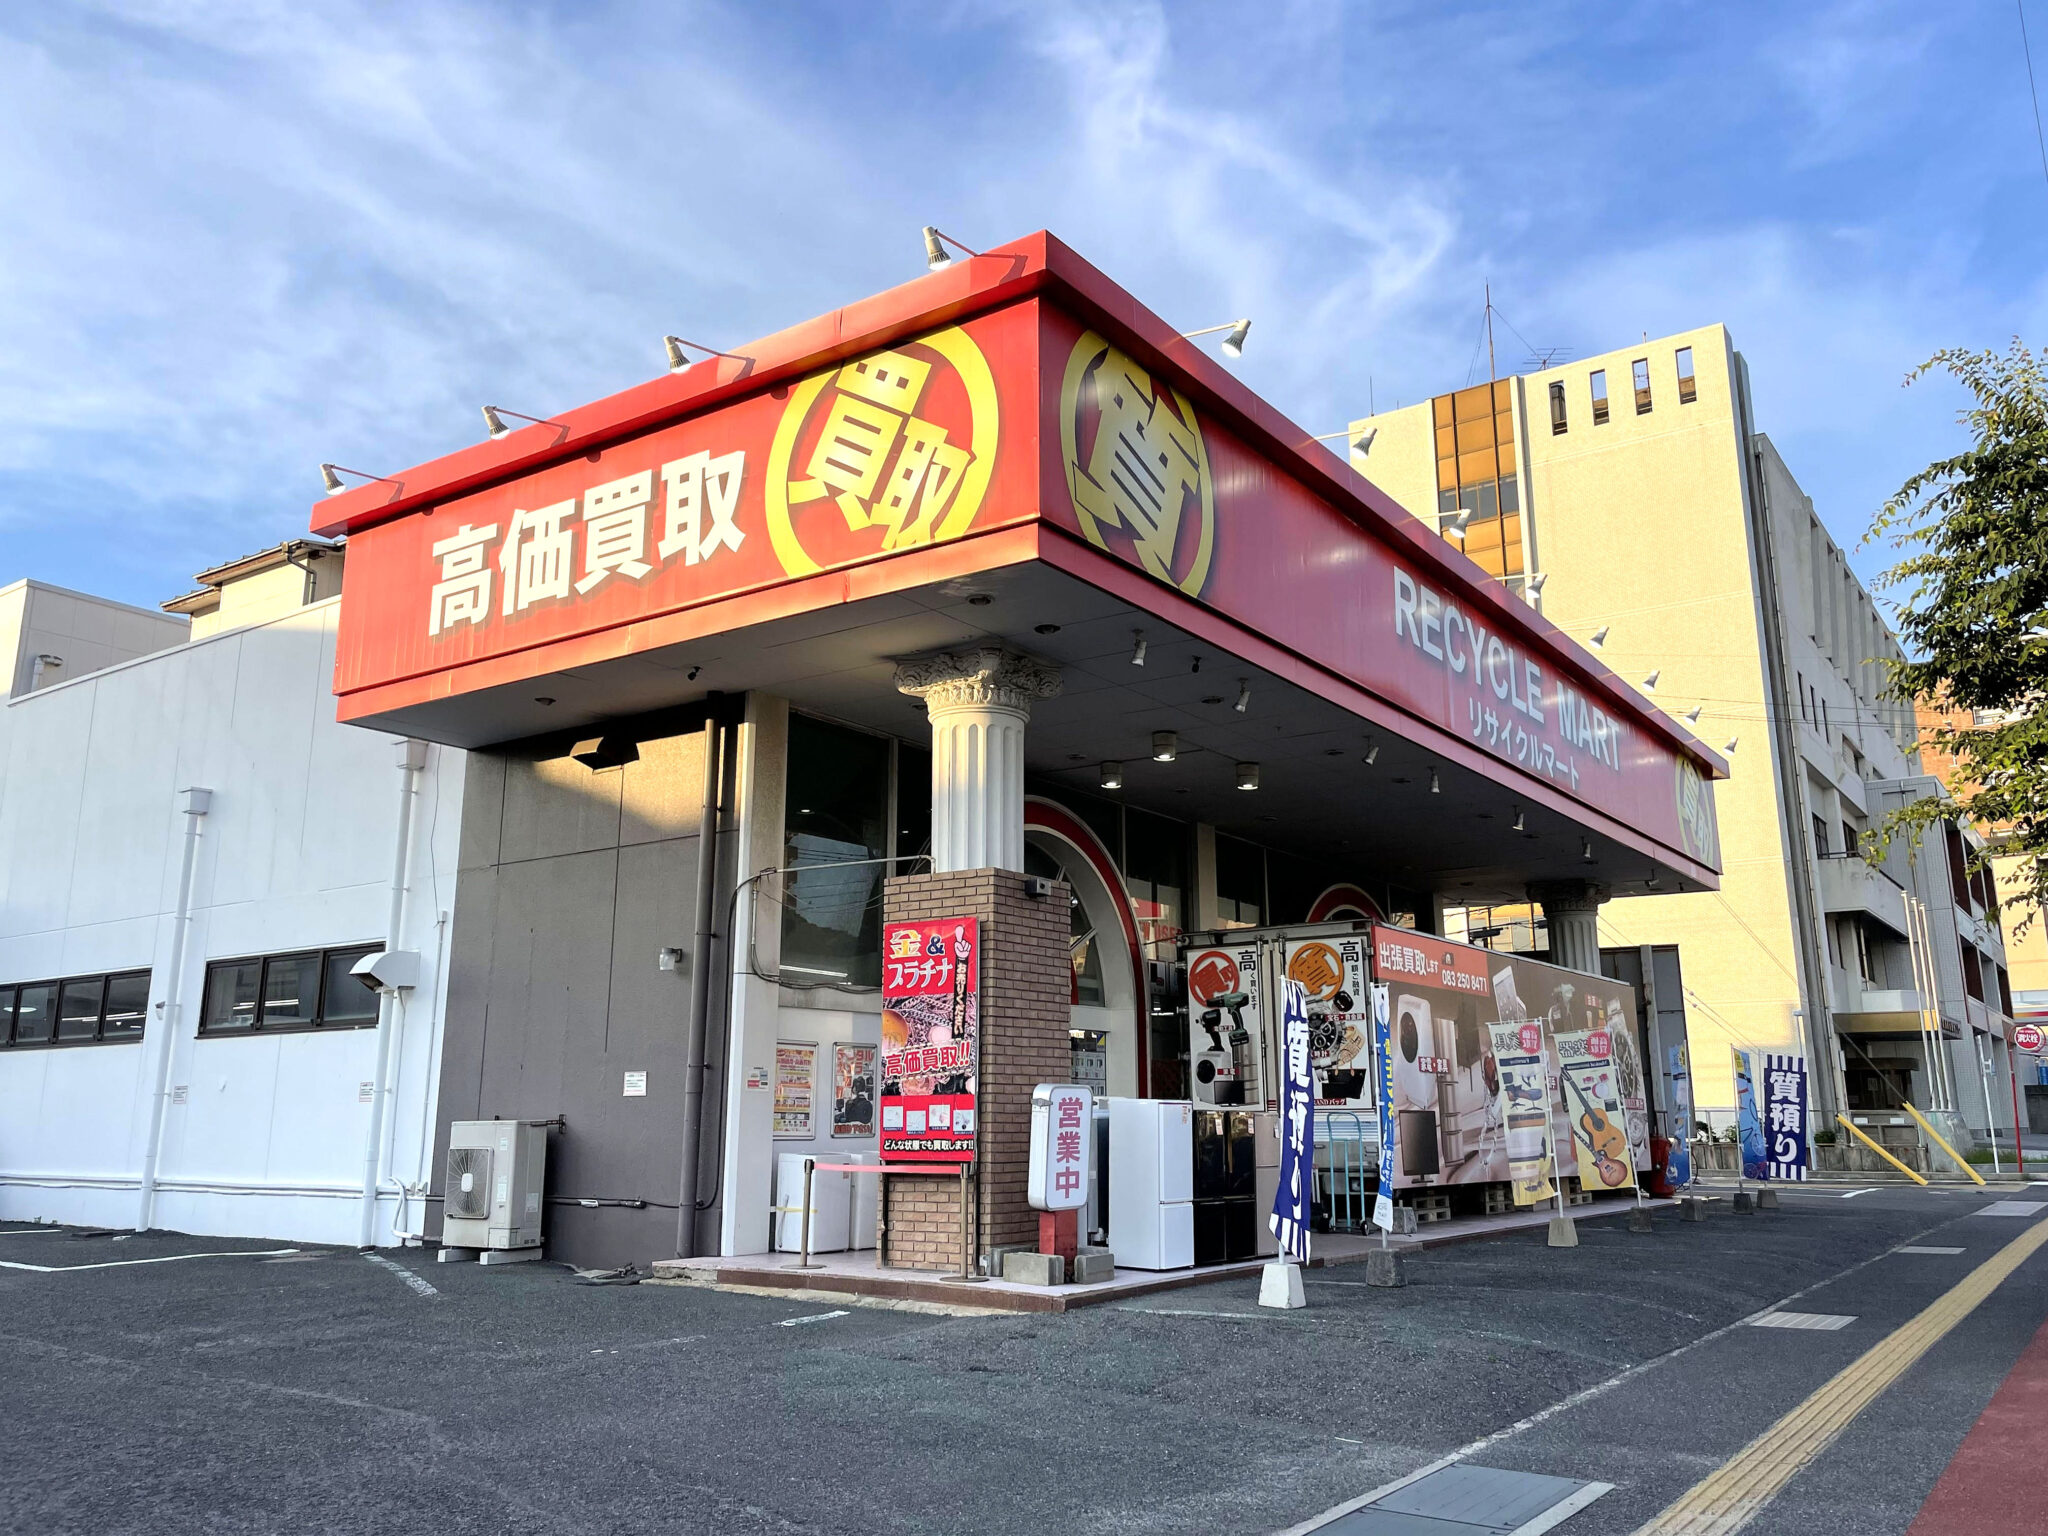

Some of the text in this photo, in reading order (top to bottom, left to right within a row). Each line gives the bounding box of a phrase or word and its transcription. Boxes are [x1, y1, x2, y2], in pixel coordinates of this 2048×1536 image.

[788, 349, 971, 551] 買取
[429, 449, 746, 637] 高価買取
[1393, 566, 1621, 771] RECYCLE MART
[1469, 697, 1580, 790] リサイクルマート
[888, 958, 953, 989] プラチナ
[954, 963, 967, 1034] お売りください
[1380, 942, 1438, 976] 出張買取します
[1442, 970, 1488, 992] 083 250 8471
[2017, 1033, 2038, 1043] 消火栓
[1055, 1097, 1083, 1199] 営業中
[1770, 1071, 1800, 1163] 質預り
